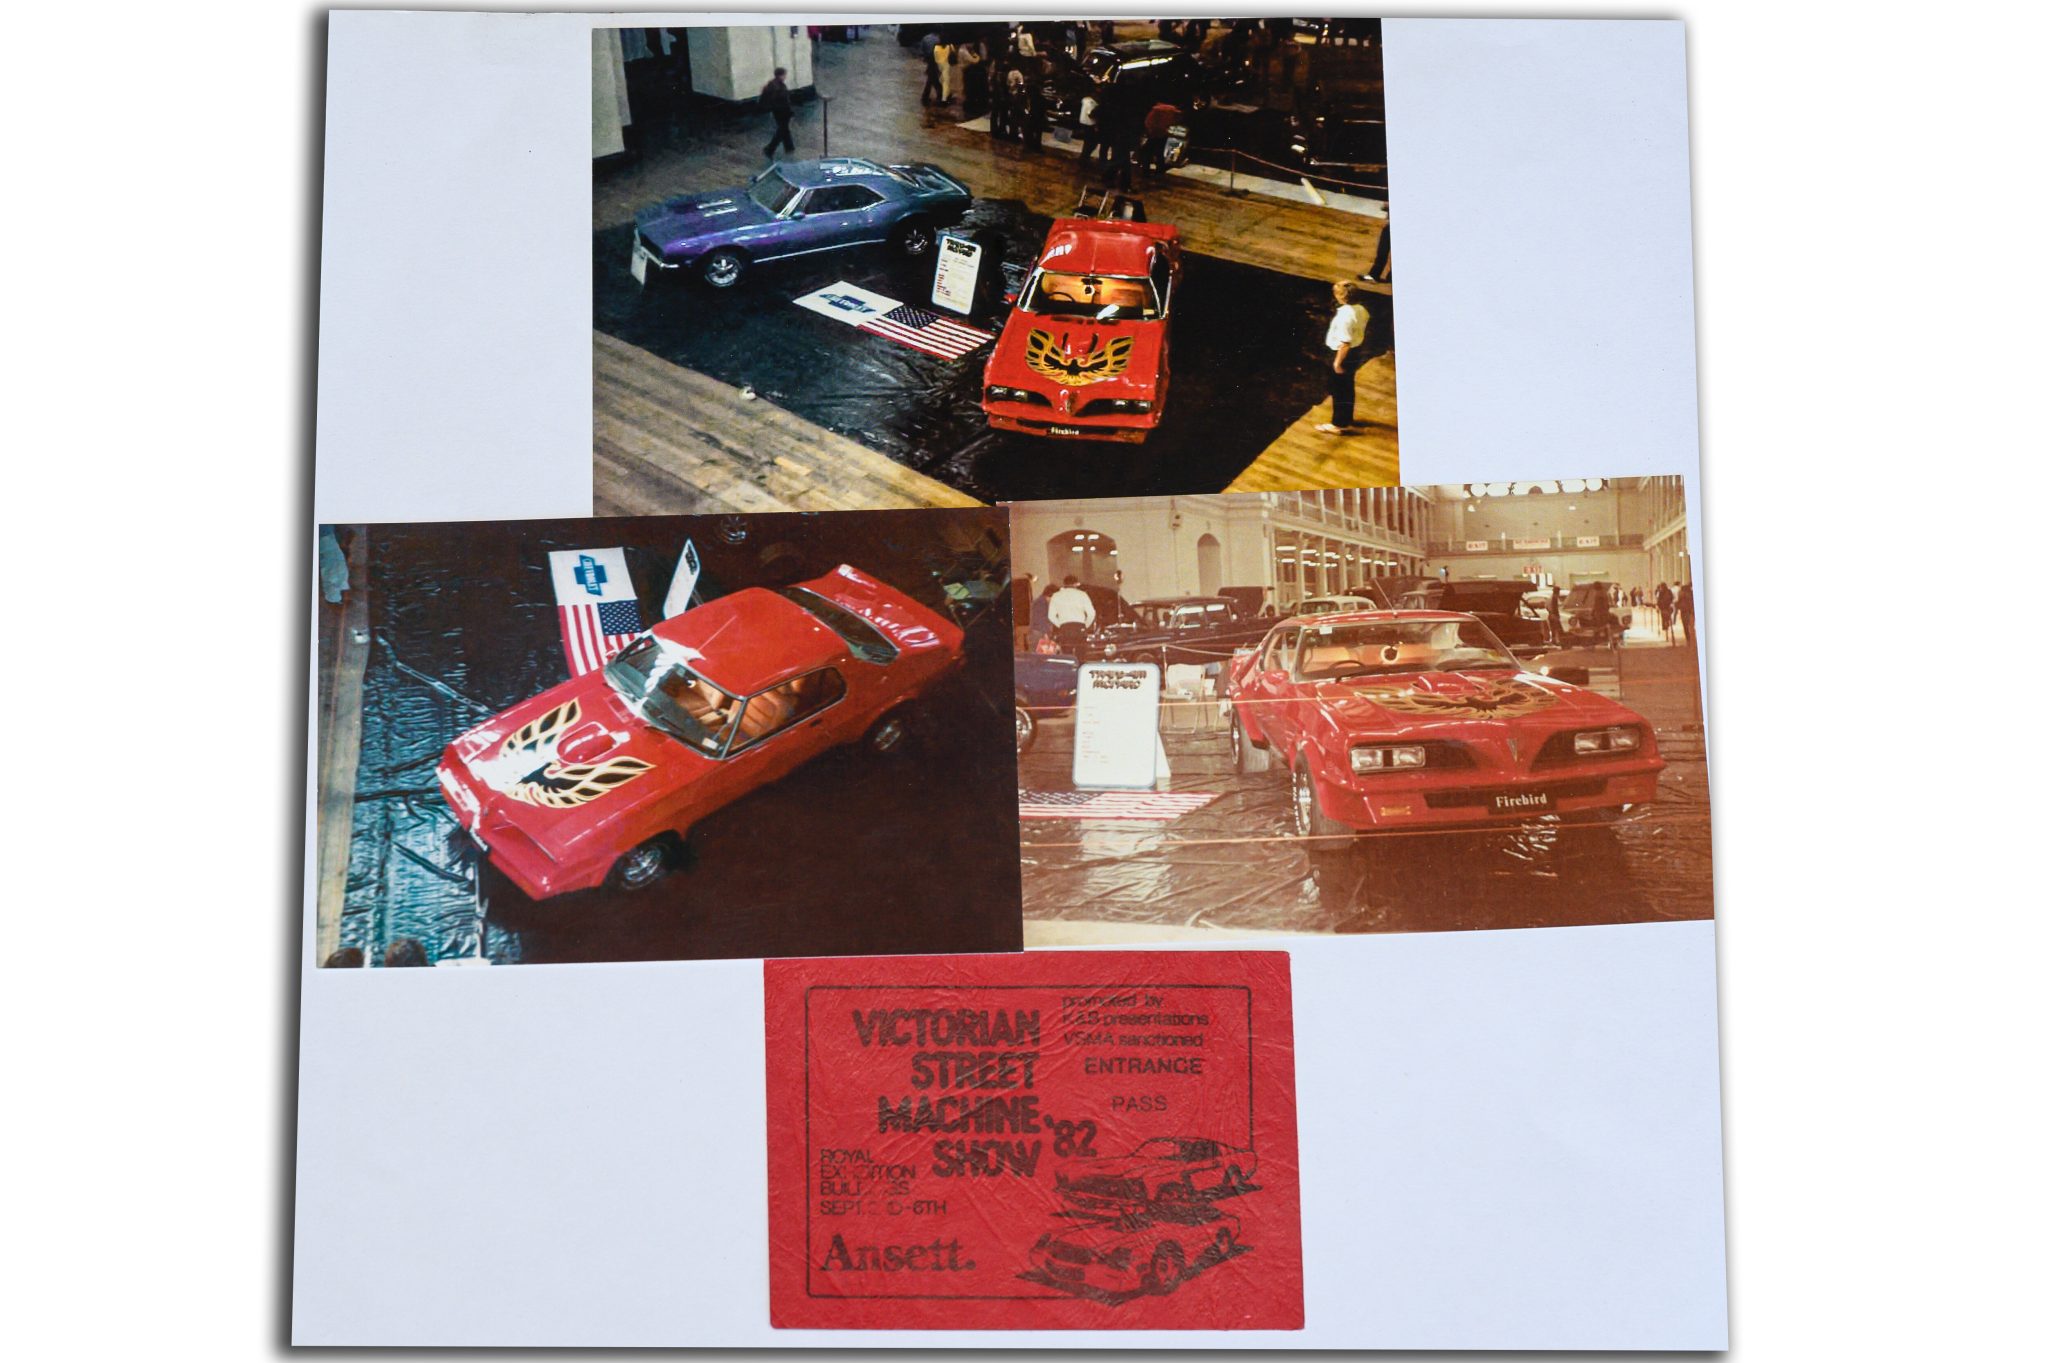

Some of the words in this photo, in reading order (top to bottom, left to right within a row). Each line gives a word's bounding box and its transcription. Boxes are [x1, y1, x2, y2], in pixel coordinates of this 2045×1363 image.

[1495, 793, 1547, 808] Firebird
[1062, 993, 1137, 1009] promoted
[853, 1008, 1041, 1047] VICTORIAN
[1103, 1012, 1209, 1027] presentations
[1119, 1032, 1204, 1047] sanctioned
[911, 1051, 1041, 1089] STREET
[1084, 1056, 1204, 1075] ENTRANCE
[1111, 1095, 1169, 1112] PASS
[878, 1095, 1042, 1134] MACHINE
[820, 1148, 875, 1164] ROYAL
[932, 1139, 1042, 1178] SHOW
[820, 1233, 977, 1272] Ansett.
